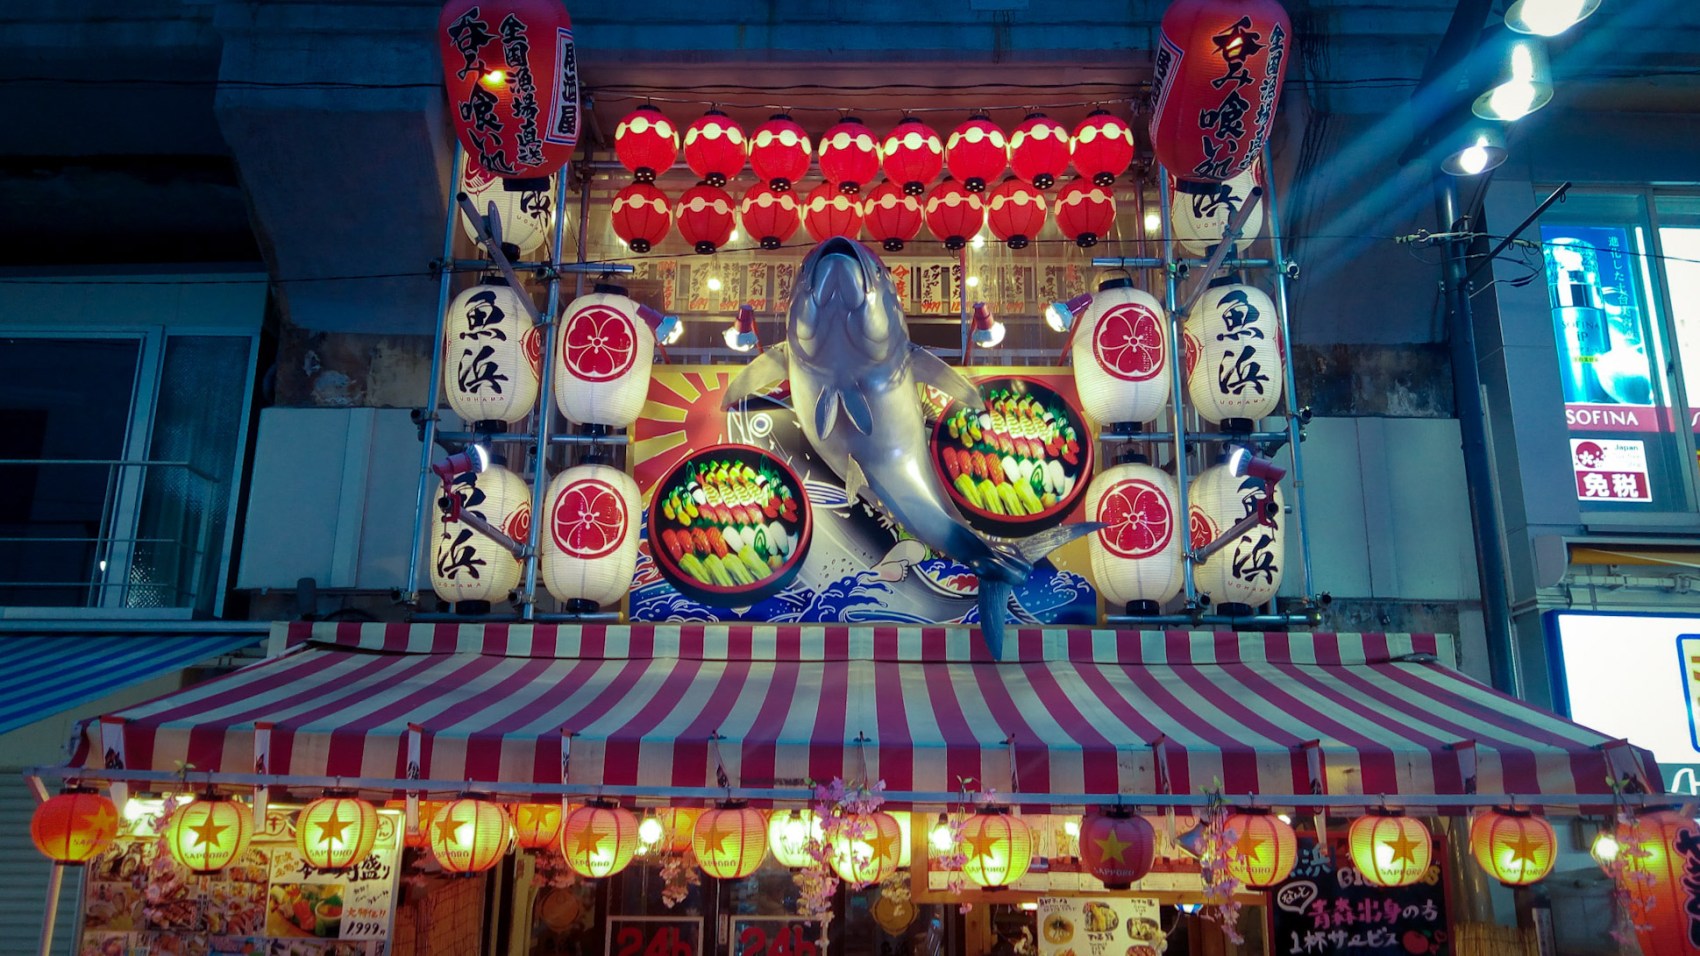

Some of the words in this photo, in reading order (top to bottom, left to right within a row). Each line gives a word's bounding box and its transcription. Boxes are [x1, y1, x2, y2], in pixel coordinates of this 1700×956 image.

[457, 290, 509, 394] 魚浜
[1216, 289, 1270, 395] 魚浜
[1566, 409, 1639, 426] SOFINA
[1615, 444, 1639, 453] Japan
[1583, 472, 1639, 498] 免税
[1308, 897, 1438, 929] 青森出身の方
